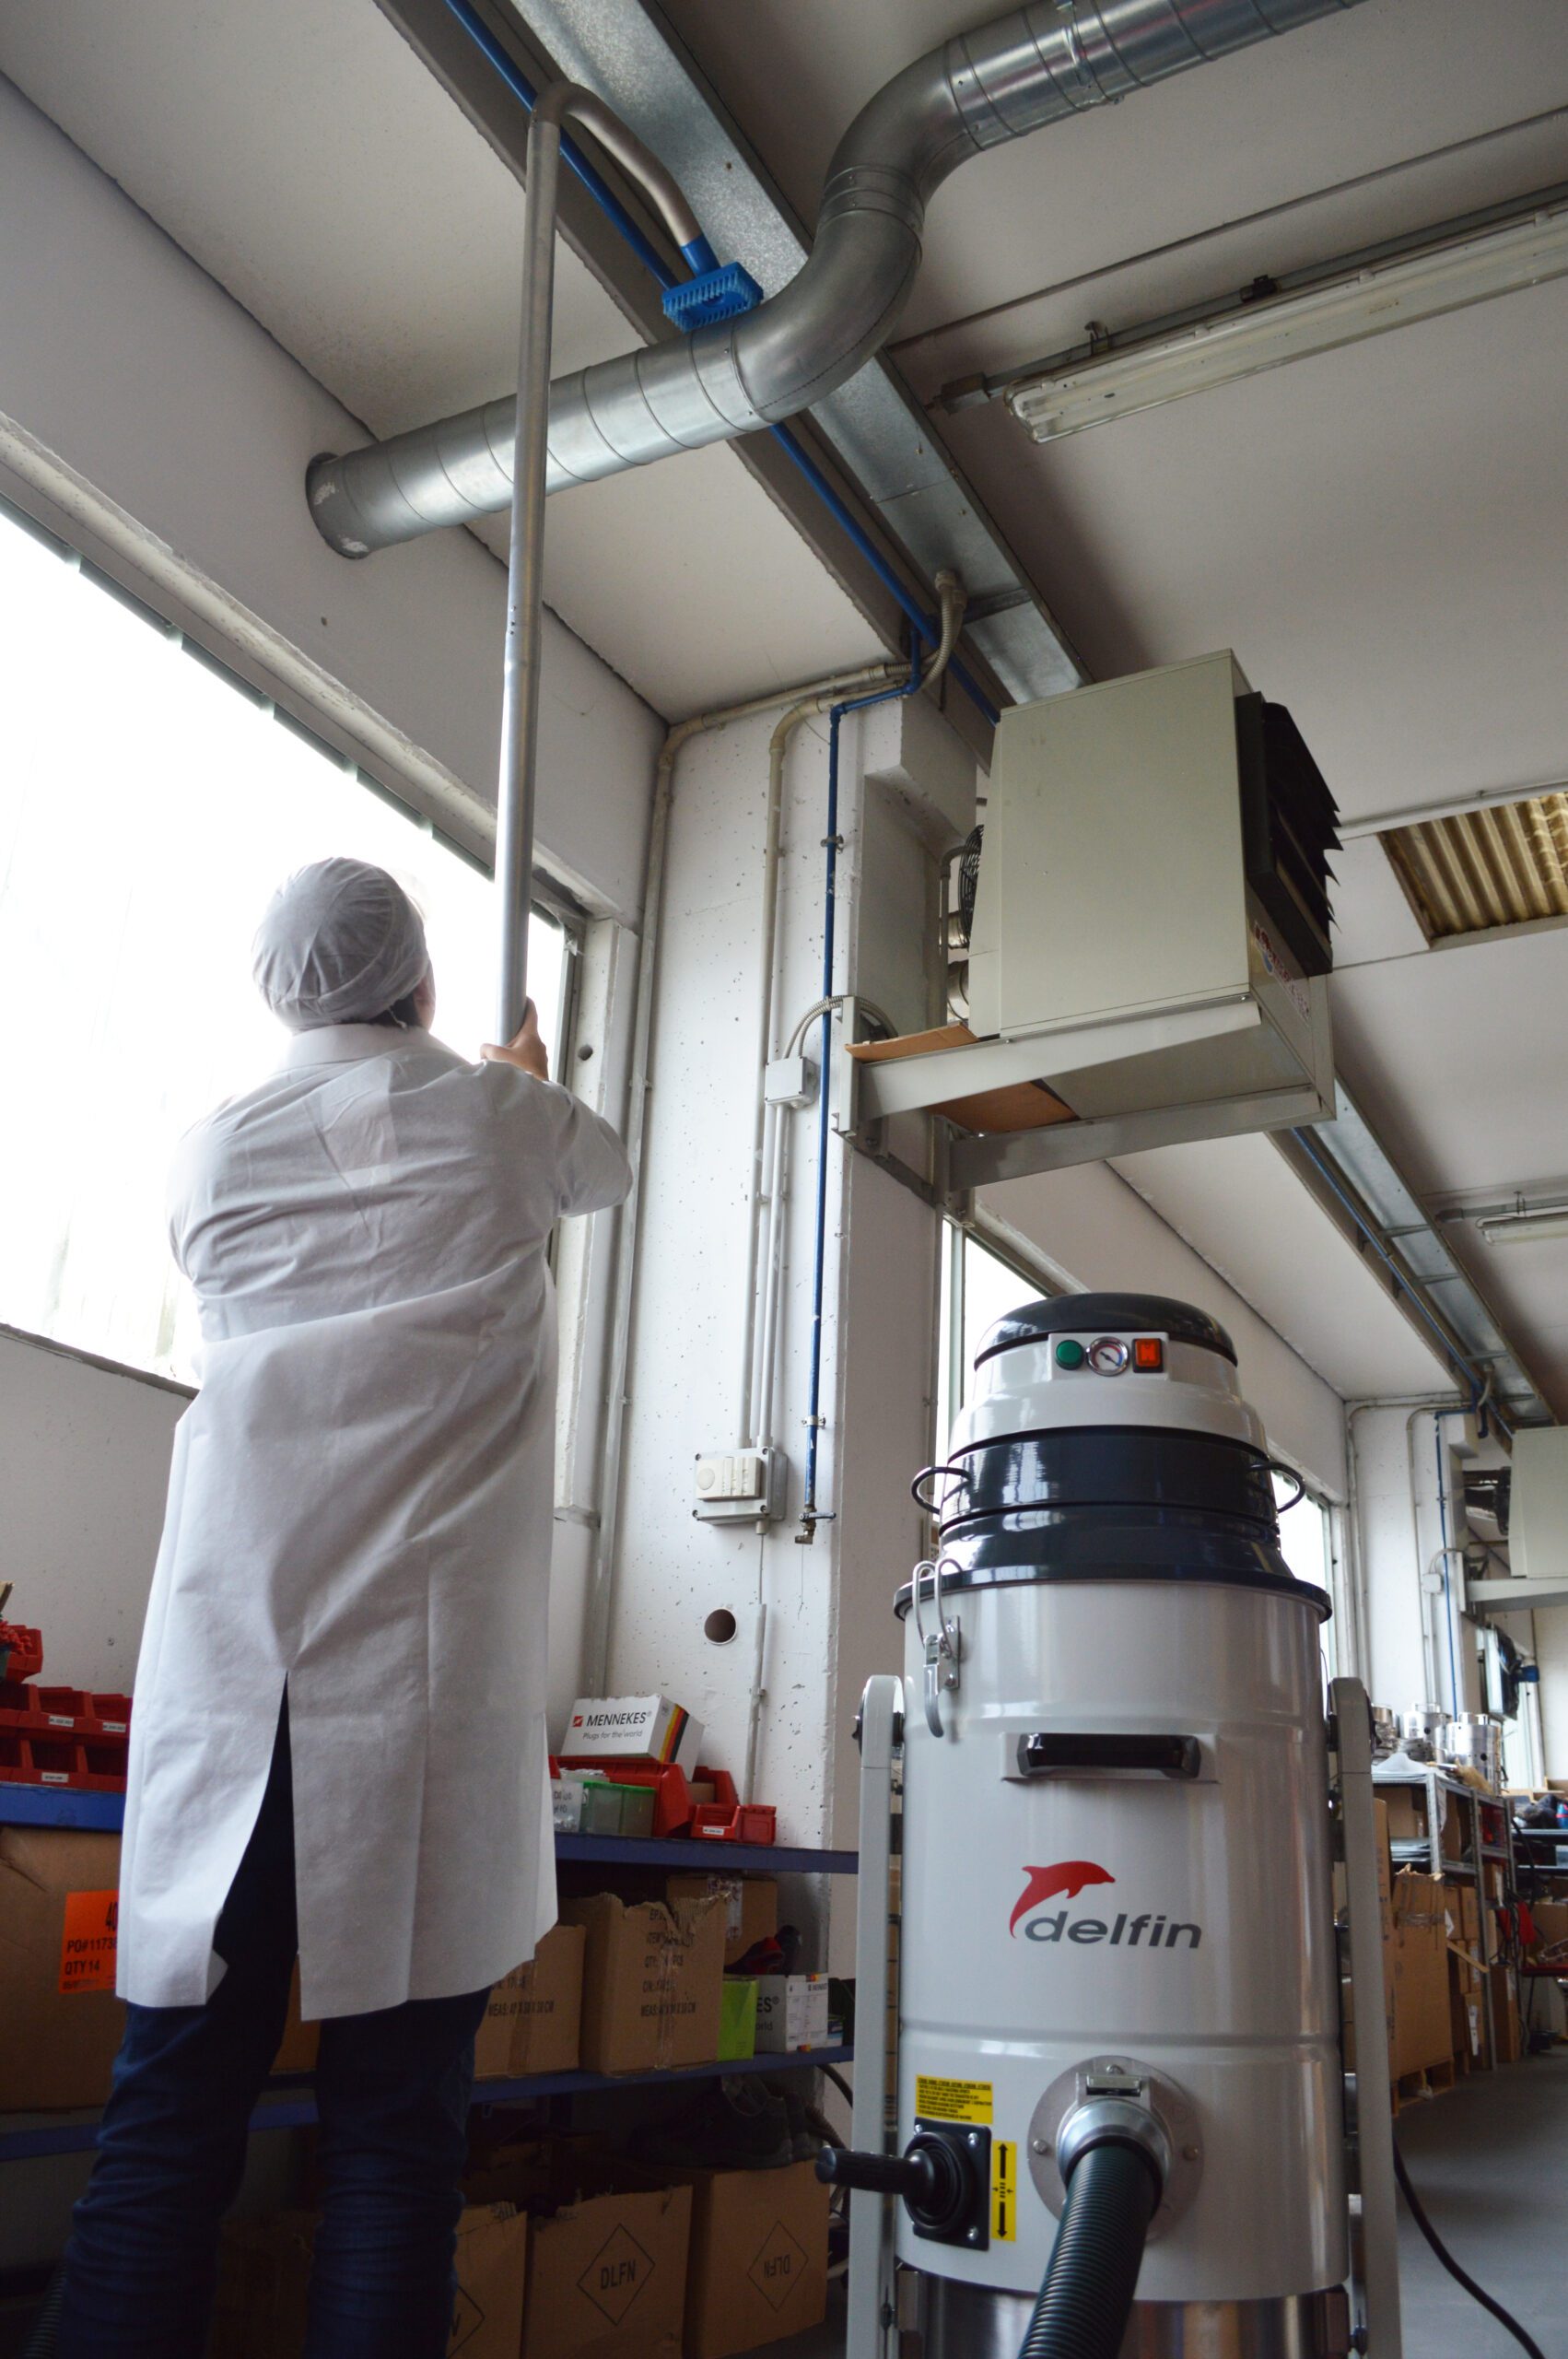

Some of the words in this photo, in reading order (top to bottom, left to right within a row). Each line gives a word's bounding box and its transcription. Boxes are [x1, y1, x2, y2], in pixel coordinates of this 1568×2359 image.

[582, 1732, 599, 1741] Plugs
[612, 1731, 622, 1739] the
[624, 1730, 643, 1738] world
[1024, 1910, 1202, 1949] delfin
[64, 1960, 87, 1976] QTY
[88, 1959, 100, 1974] 14
[755, 2021, 773, 2031] orld
[601, 2259, 636, 2290] DLFN
[764, 2254, 791, 2279] DLFN
